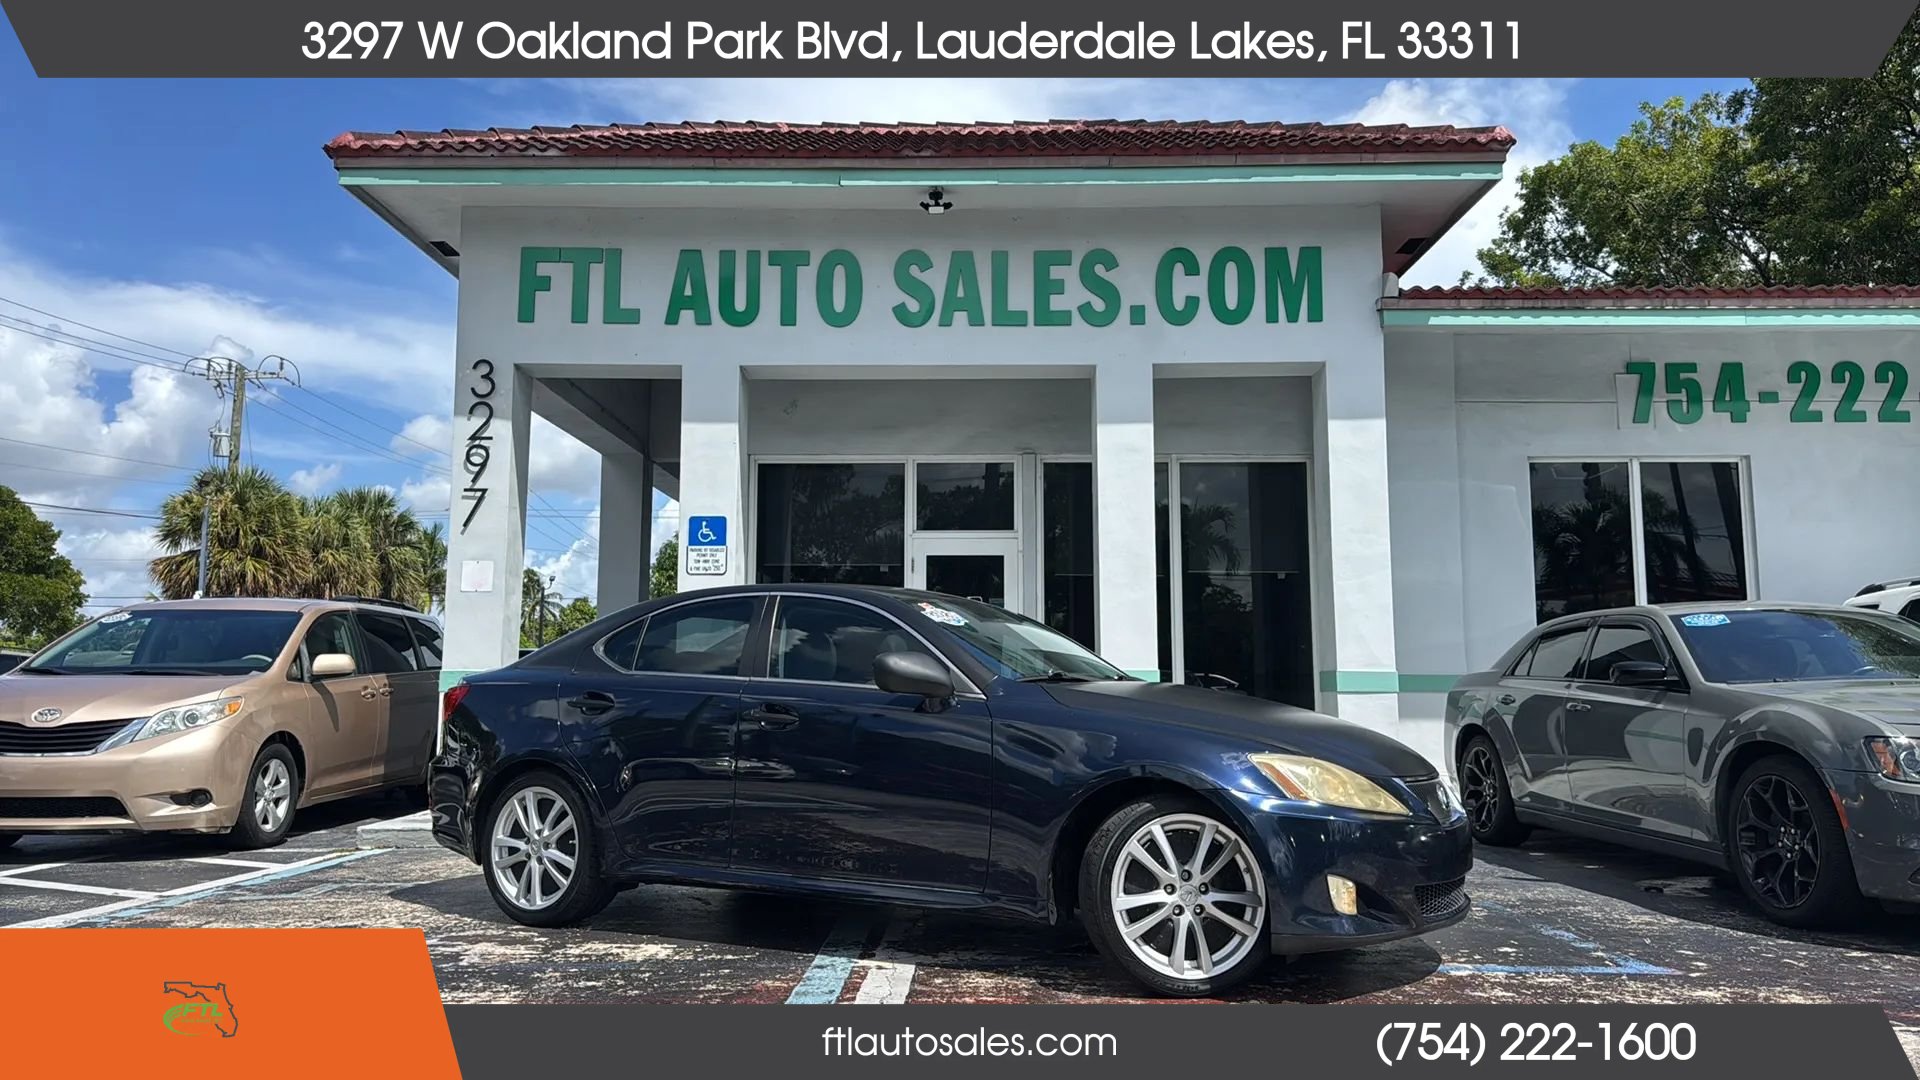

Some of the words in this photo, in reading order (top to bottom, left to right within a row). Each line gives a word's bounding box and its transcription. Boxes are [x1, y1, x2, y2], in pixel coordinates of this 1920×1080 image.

[517, 247, 641, 325] FTL
[664, 248, 864, 328] AUTO
[891, 246, 1324, 328] SALES.COM
[1626, 361, 1920, 424] 754-222
[462, 358, 496, 528] 3297
